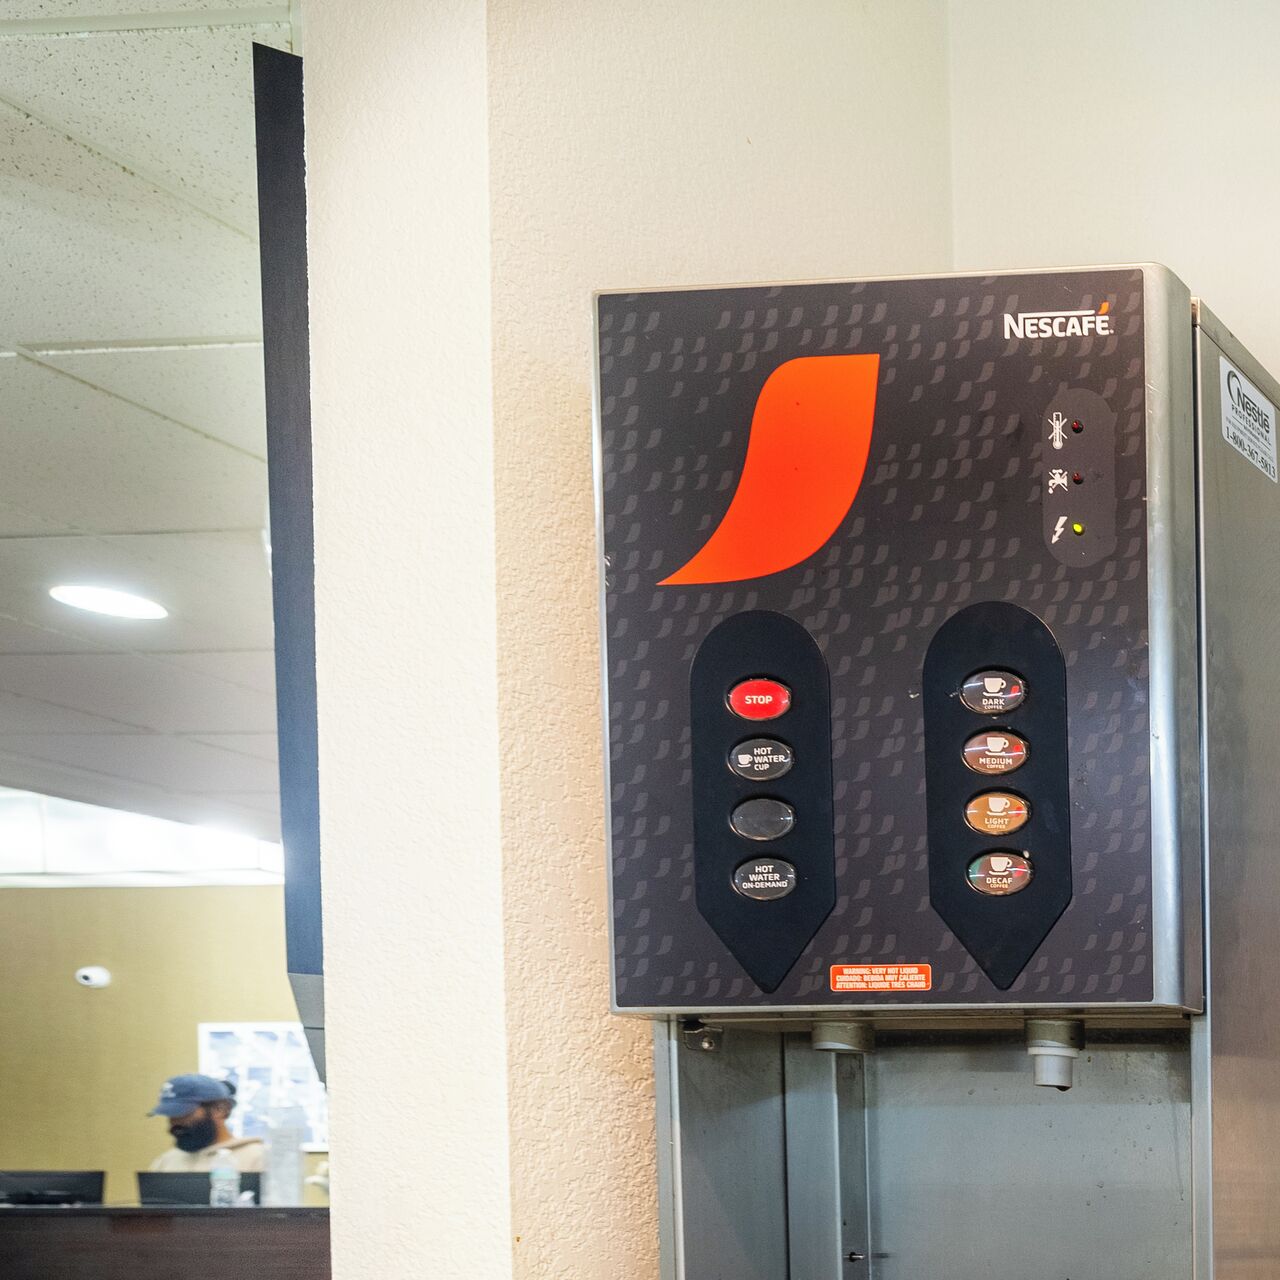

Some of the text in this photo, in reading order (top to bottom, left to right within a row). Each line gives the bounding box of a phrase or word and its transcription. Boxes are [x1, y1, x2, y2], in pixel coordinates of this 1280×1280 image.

[1226, 426, 1277, 479] 1-800-367-5813
[744, 695, 773, 705] STOP
[753, 747, 773, 755] HOT
[753, 755, 785, 763] WATER
[979, 757, 1013, 765] MEDIUM
[754, 763, 770, 771] CUP
[984, 817, 1009, 825] LIGHT
[755, 865, 775, 873] HOT
[748, 873, 781, 881] WATER
[986, 877, 1013, 885] DECAF
[742, 880, 788, 889] ON-DEMAND
